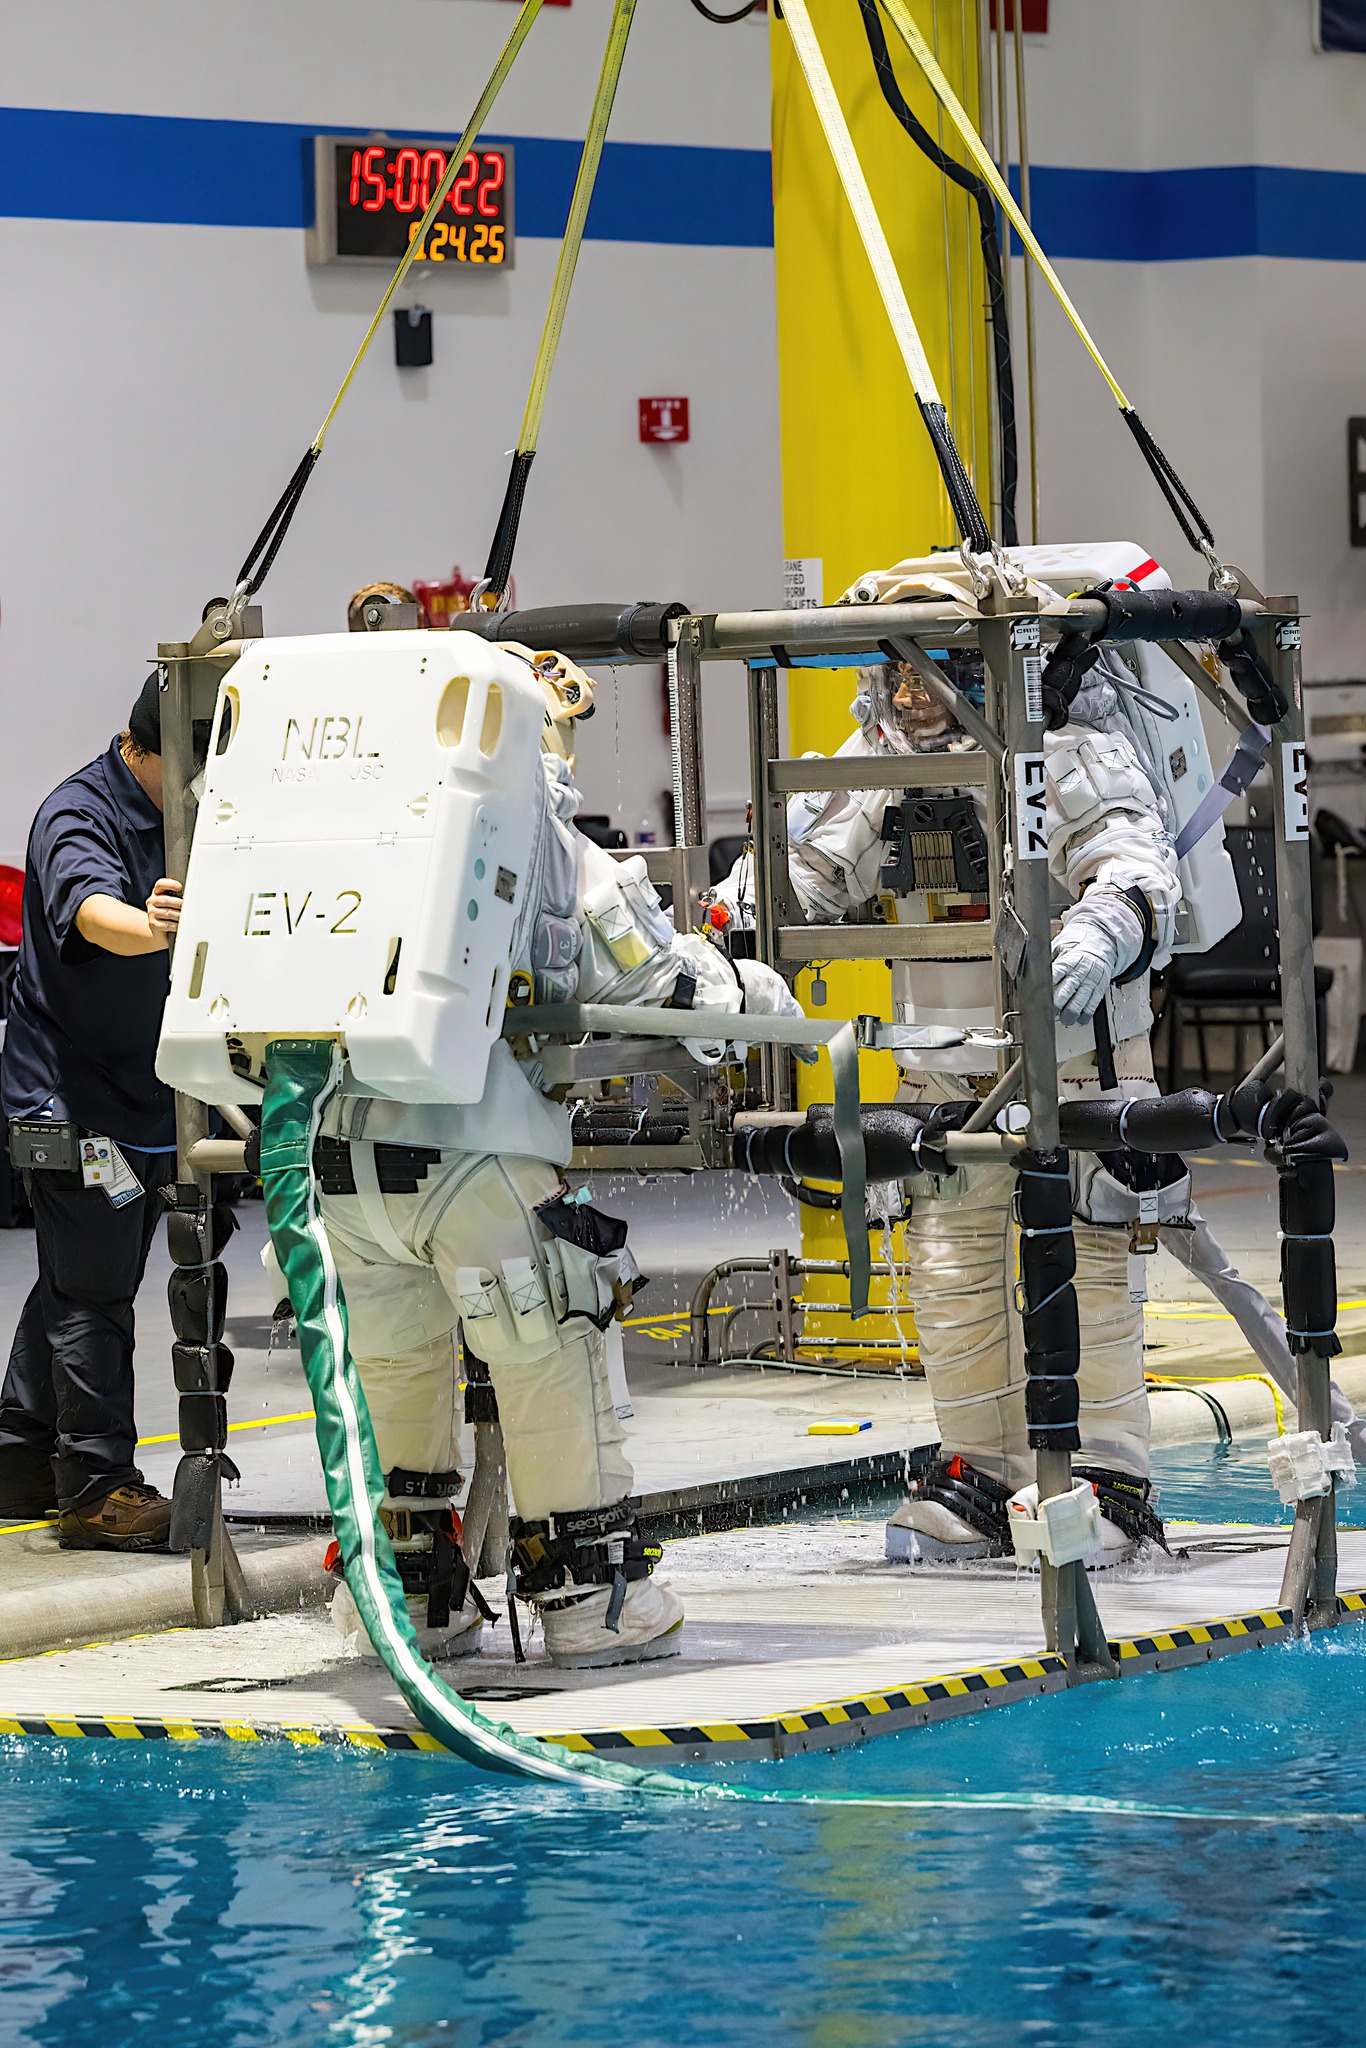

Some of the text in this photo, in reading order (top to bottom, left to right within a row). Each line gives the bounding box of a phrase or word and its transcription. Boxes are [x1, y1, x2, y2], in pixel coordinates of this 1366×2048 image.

[282, 716, 380, 761] NBL
[271, 763, 385, 784] NASA JSC
[1024, 760, 1049, 852] EV-2
[244, 889, 363, 937] EV-2
